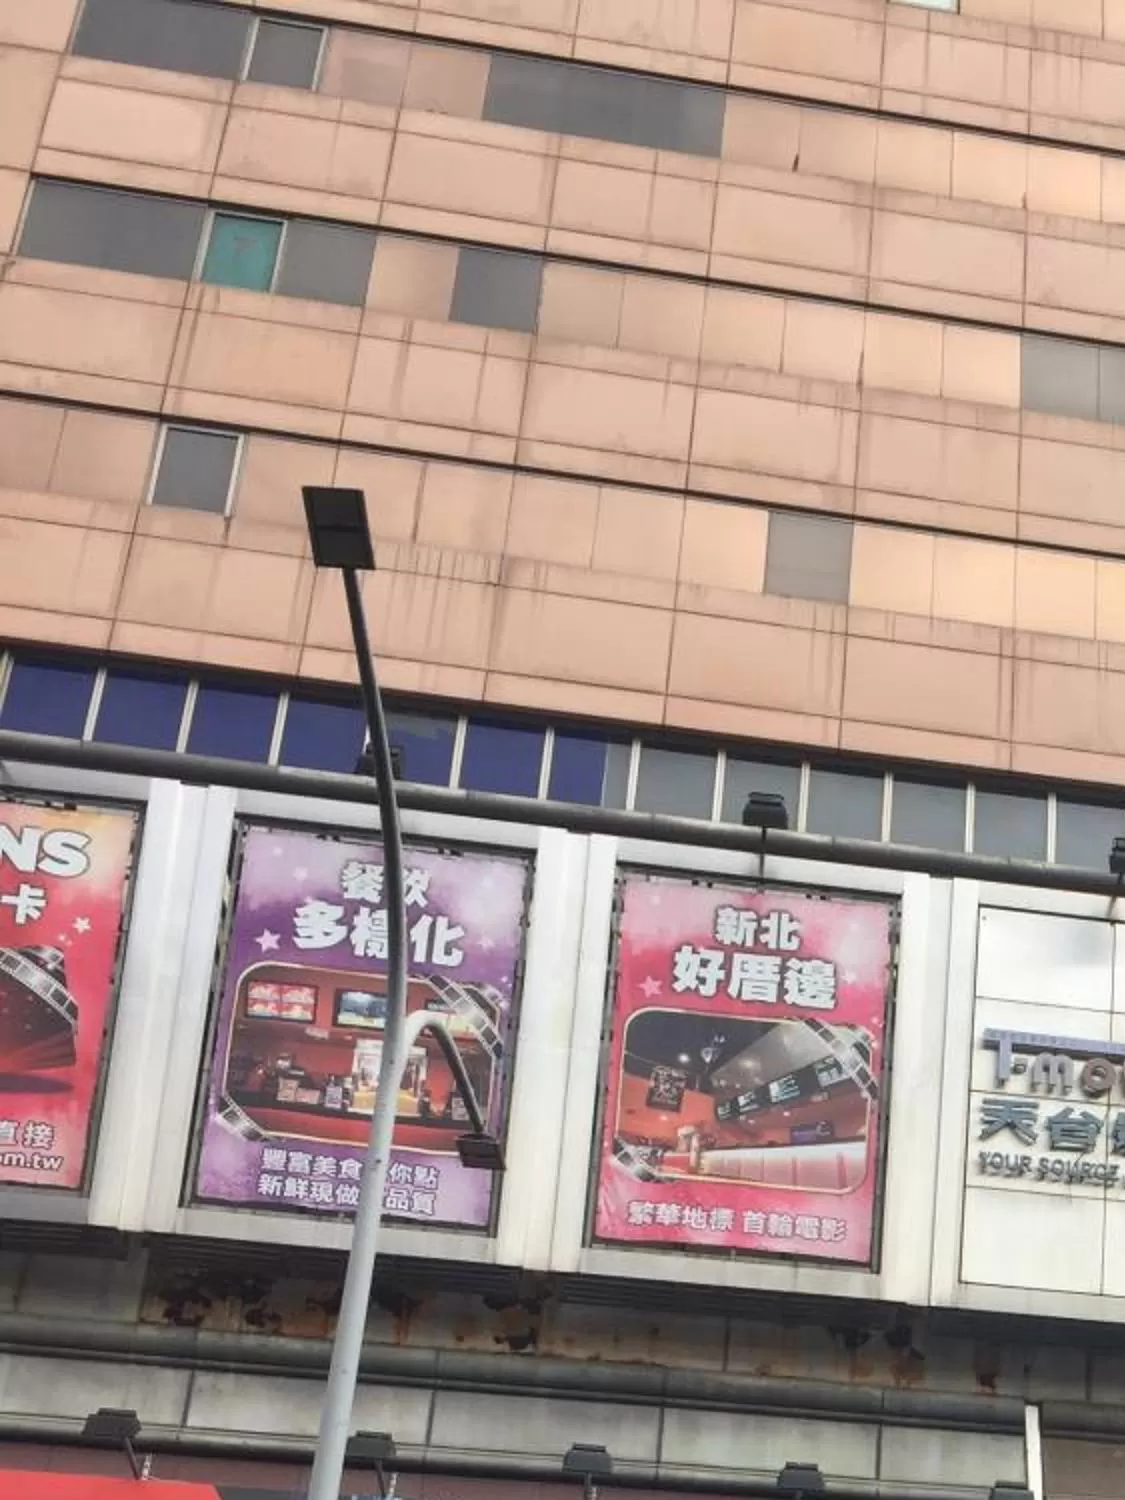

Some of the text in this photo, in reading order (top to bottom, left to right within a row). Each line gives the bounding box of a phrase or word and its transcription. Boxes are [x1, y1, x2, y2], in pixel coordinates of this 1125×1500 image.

[713, 905, 801, 952] 新北
[672, 945, 838, 1010] 好厝邊
[0, 1152, 64, 1169] m.tw
[262, 1148, 440, 1190] 豐富美食你點
[978, 1151, 1032, 1176] YOUR
[1038, 1158, 1120, 1187] SOURCE
[257, 1173, 437, 1216] 新鮮現做品質
[627, 1201, 847, 1243] 繁華地標 首輪電影
